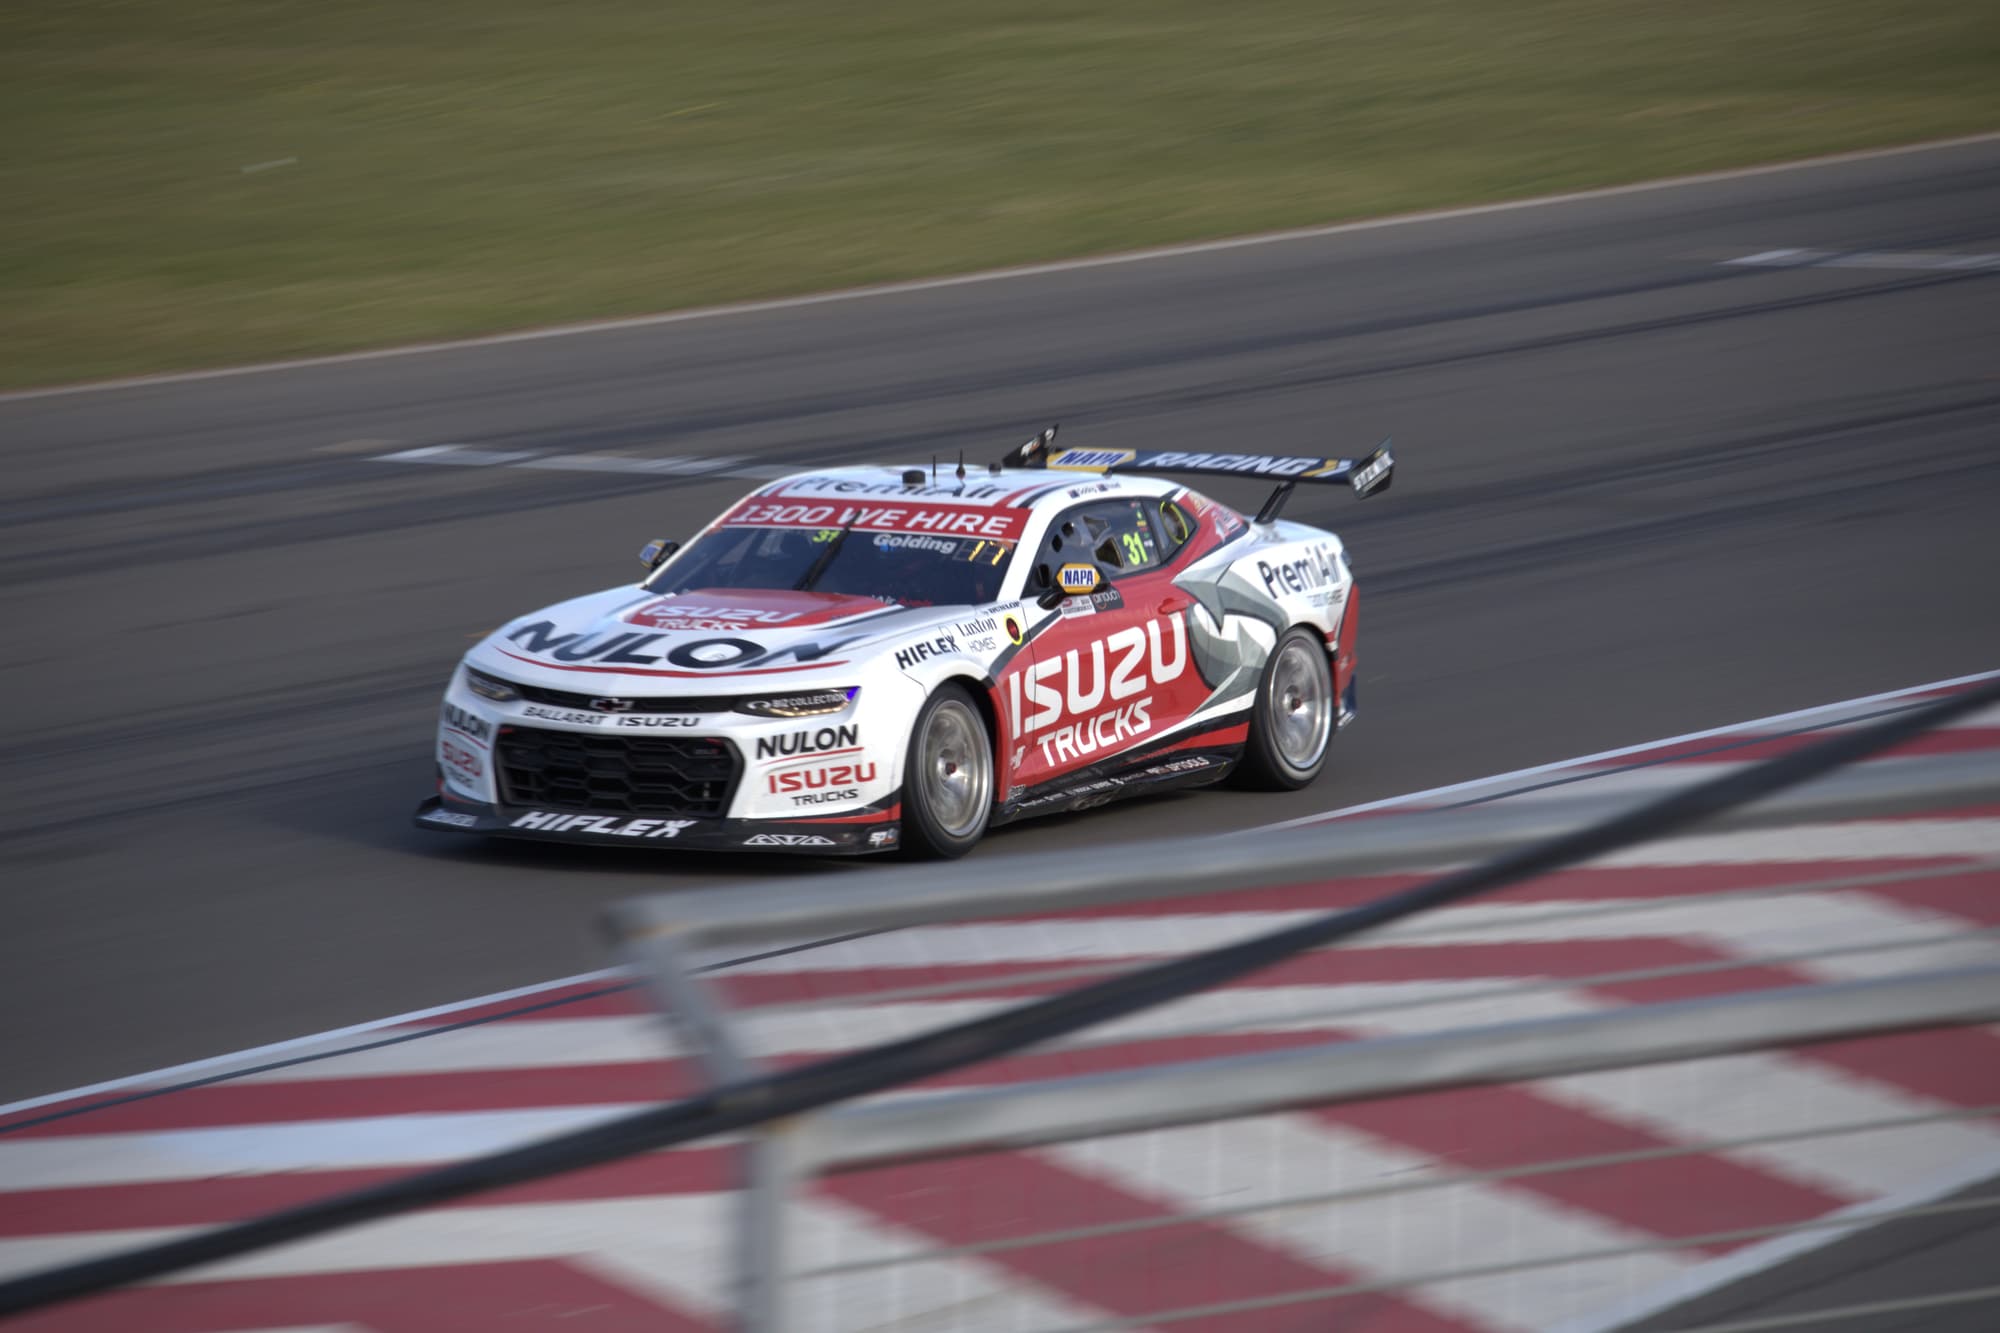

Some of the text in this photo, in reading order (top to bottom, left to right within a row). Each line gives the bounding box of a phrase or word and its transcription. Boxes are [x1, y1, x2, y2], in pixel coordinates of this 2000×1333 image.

[1054, 449, 1320, 475] NAPA RACING
[730, 504, 1013, 535] 1300 WE HIRE
[873, 533, 957, 554] Golding
[1122, 531, 1148, 566] 31
[1063, 568, 1094, 586] NAPA
[1256, 543, 1343, 600] PremiAir
[640, 604, 803, 624] ISUZU
[654, 618, 749, 632] TRUCKS
[955, 617, 998, 637] Luxton
[505, 620, 874, 669] NULON
[895, 634, 961, 670] HIFLEX
[968, 636, 997, 653] HOMES
[1008, 611, 1187, 741] ISUZU
[522, 706, 700, 729] BALLARAT ISUZU
[1037, 695, 1153, 768] TRUCKS
[756, 723, 859, 761] NULON
[768, 762, 877, 794] ISUZU
[790, 788, 859, 807] TRUCKS
[508, 811, 700, 839] HIFLEX
